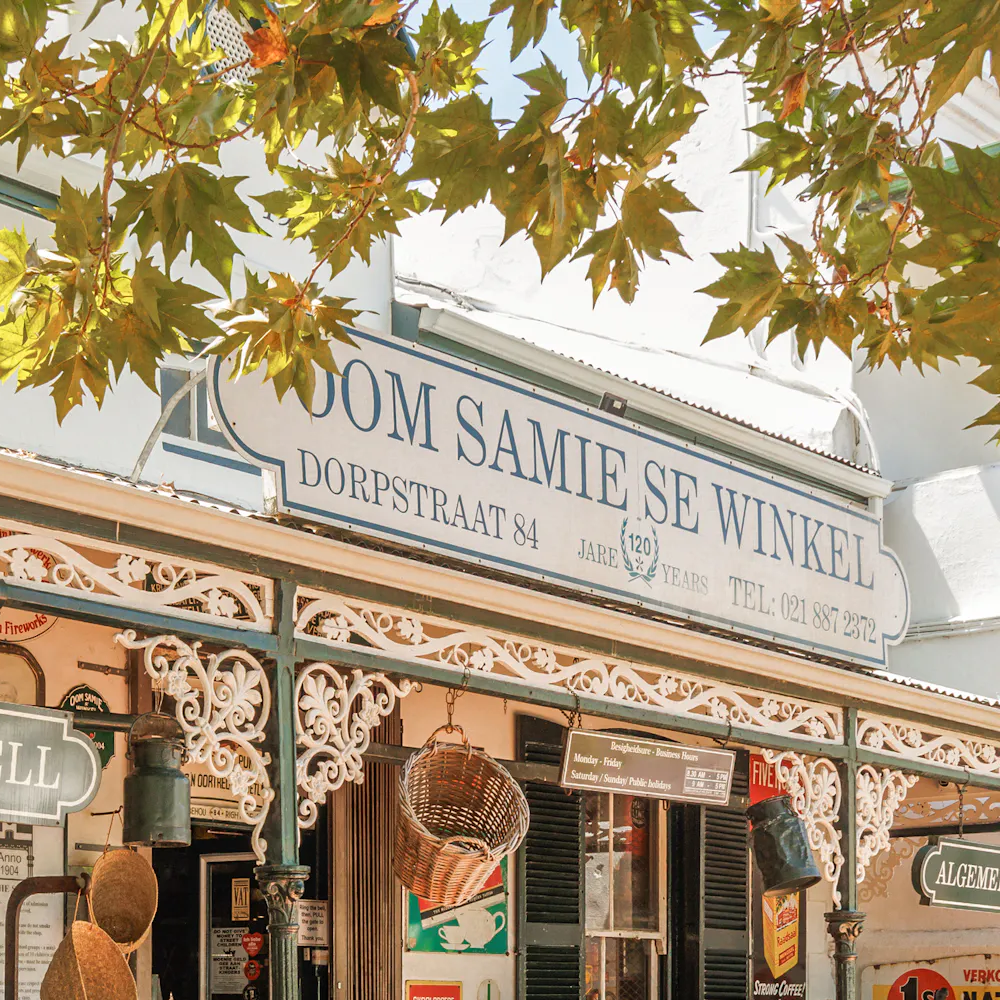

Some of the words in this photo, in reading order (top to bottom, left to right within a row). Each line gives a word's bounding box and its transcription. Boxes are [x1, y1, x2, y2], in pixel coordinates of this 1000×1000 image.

[297, 448, 507, 541] DORPSTRAAT
[513, 513, 540, 550] 84
[456, 395, 627, 512] SAMIE
[644, 460, 700, 534] SE
[711, 483, 875, 591] WINKEL
[577, 538, 619, 569] JARE
[628, 533, 651, 556] 120
[661, 563, 709, 596] YEARS
[729, 575, 776, 617] TEL:
[781, 592, 808, 626] 021
[812, 601, 839, 634] 887
[843, 610, 877, 645] 2372
[4, 614, 48, 636] Fireworks
[573, 753, 599, 767] Monday
[603, 757, 622, 770] Friday
[610, 741, 651, 755] Besigheidsure
[656, 747, 680, 759] Business
[681, 751, 699, 762] Hours
[570, 769, 599, 783] Saturday
[629, 776, 648, 788] Public
[647, 779, 672, 792] holidays
[697, 771, 706, 779] AM
[752, 760, 774, 788] FIVE
[225, 811, 242, 819] RIGH
[0, 865, 19, 876] 1904
[234, 887, 248, 906] VAT
[963, 969, 1000, 983] VERKO
[753, 980, 780, 996] STRONG
